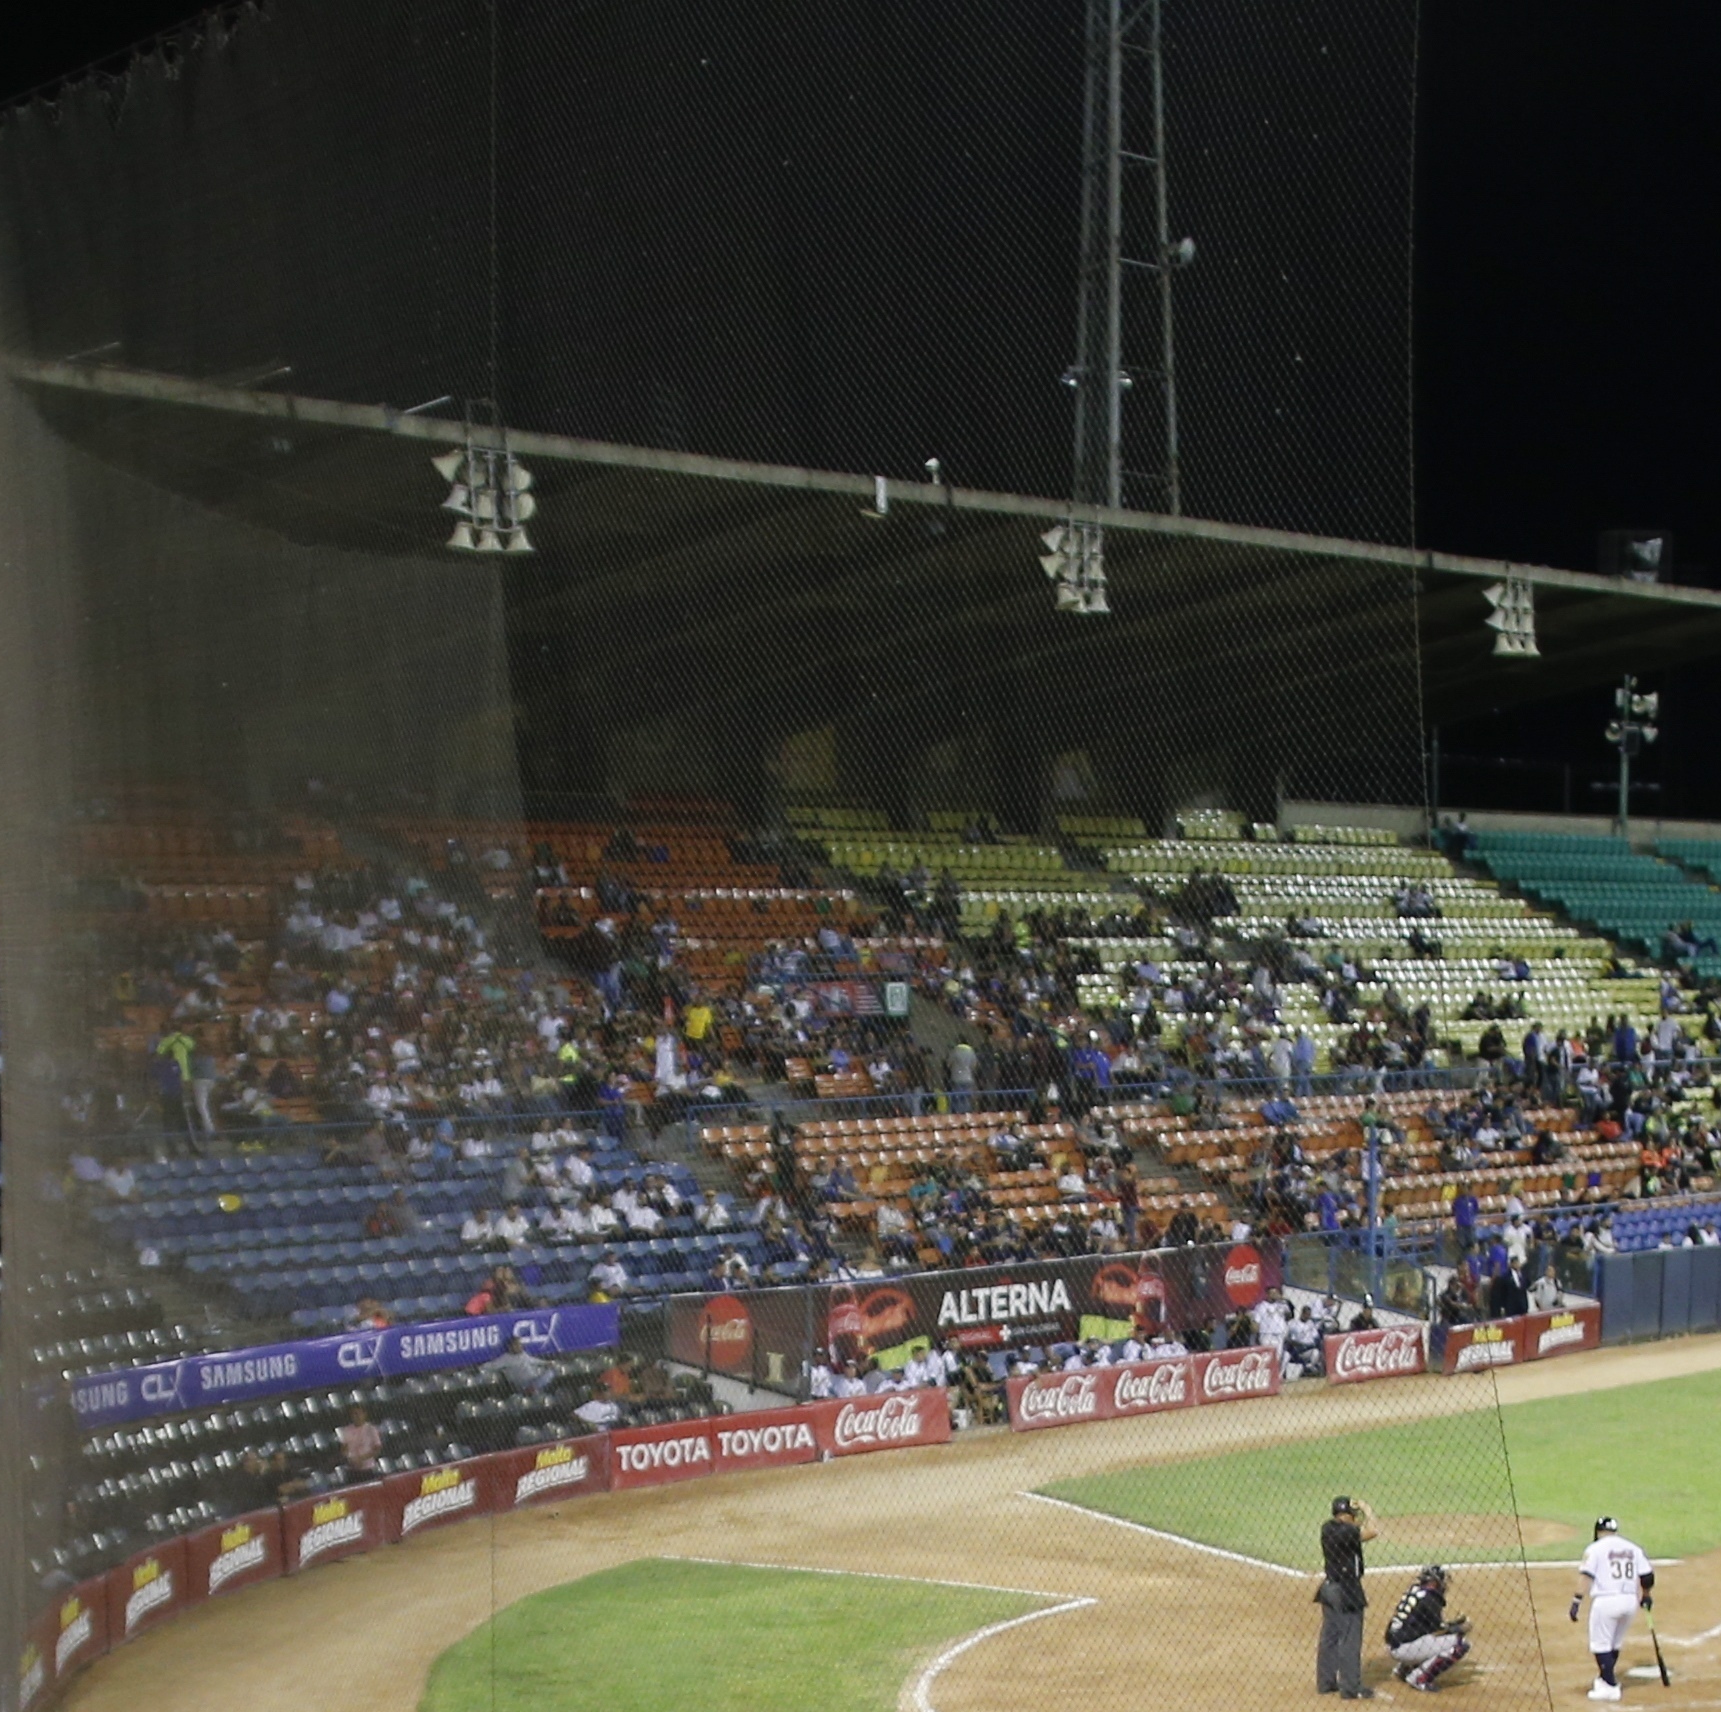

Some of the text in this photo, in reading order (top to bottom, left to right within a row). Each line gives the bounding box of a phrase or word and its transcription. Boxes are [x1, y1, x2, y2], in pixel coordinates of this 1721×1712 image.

[936, 1278, 1072, 1328] ALTERNA
[72, 1380, 129, 1414] SUNG
[199, 1354, 297, 1390] SAMSUNG
[399, 1324, 499, 1358] SAMSUNG
[616, 1435, 711, 1472] TOYOTA
[718, 1423, 814, 1458] TOYOTA
[514, 1454, 589, 1504] REGIONAL
[400, 1477, 477, 1536] REGIONAL
[1610, 1560, 1635, 1580] 38
